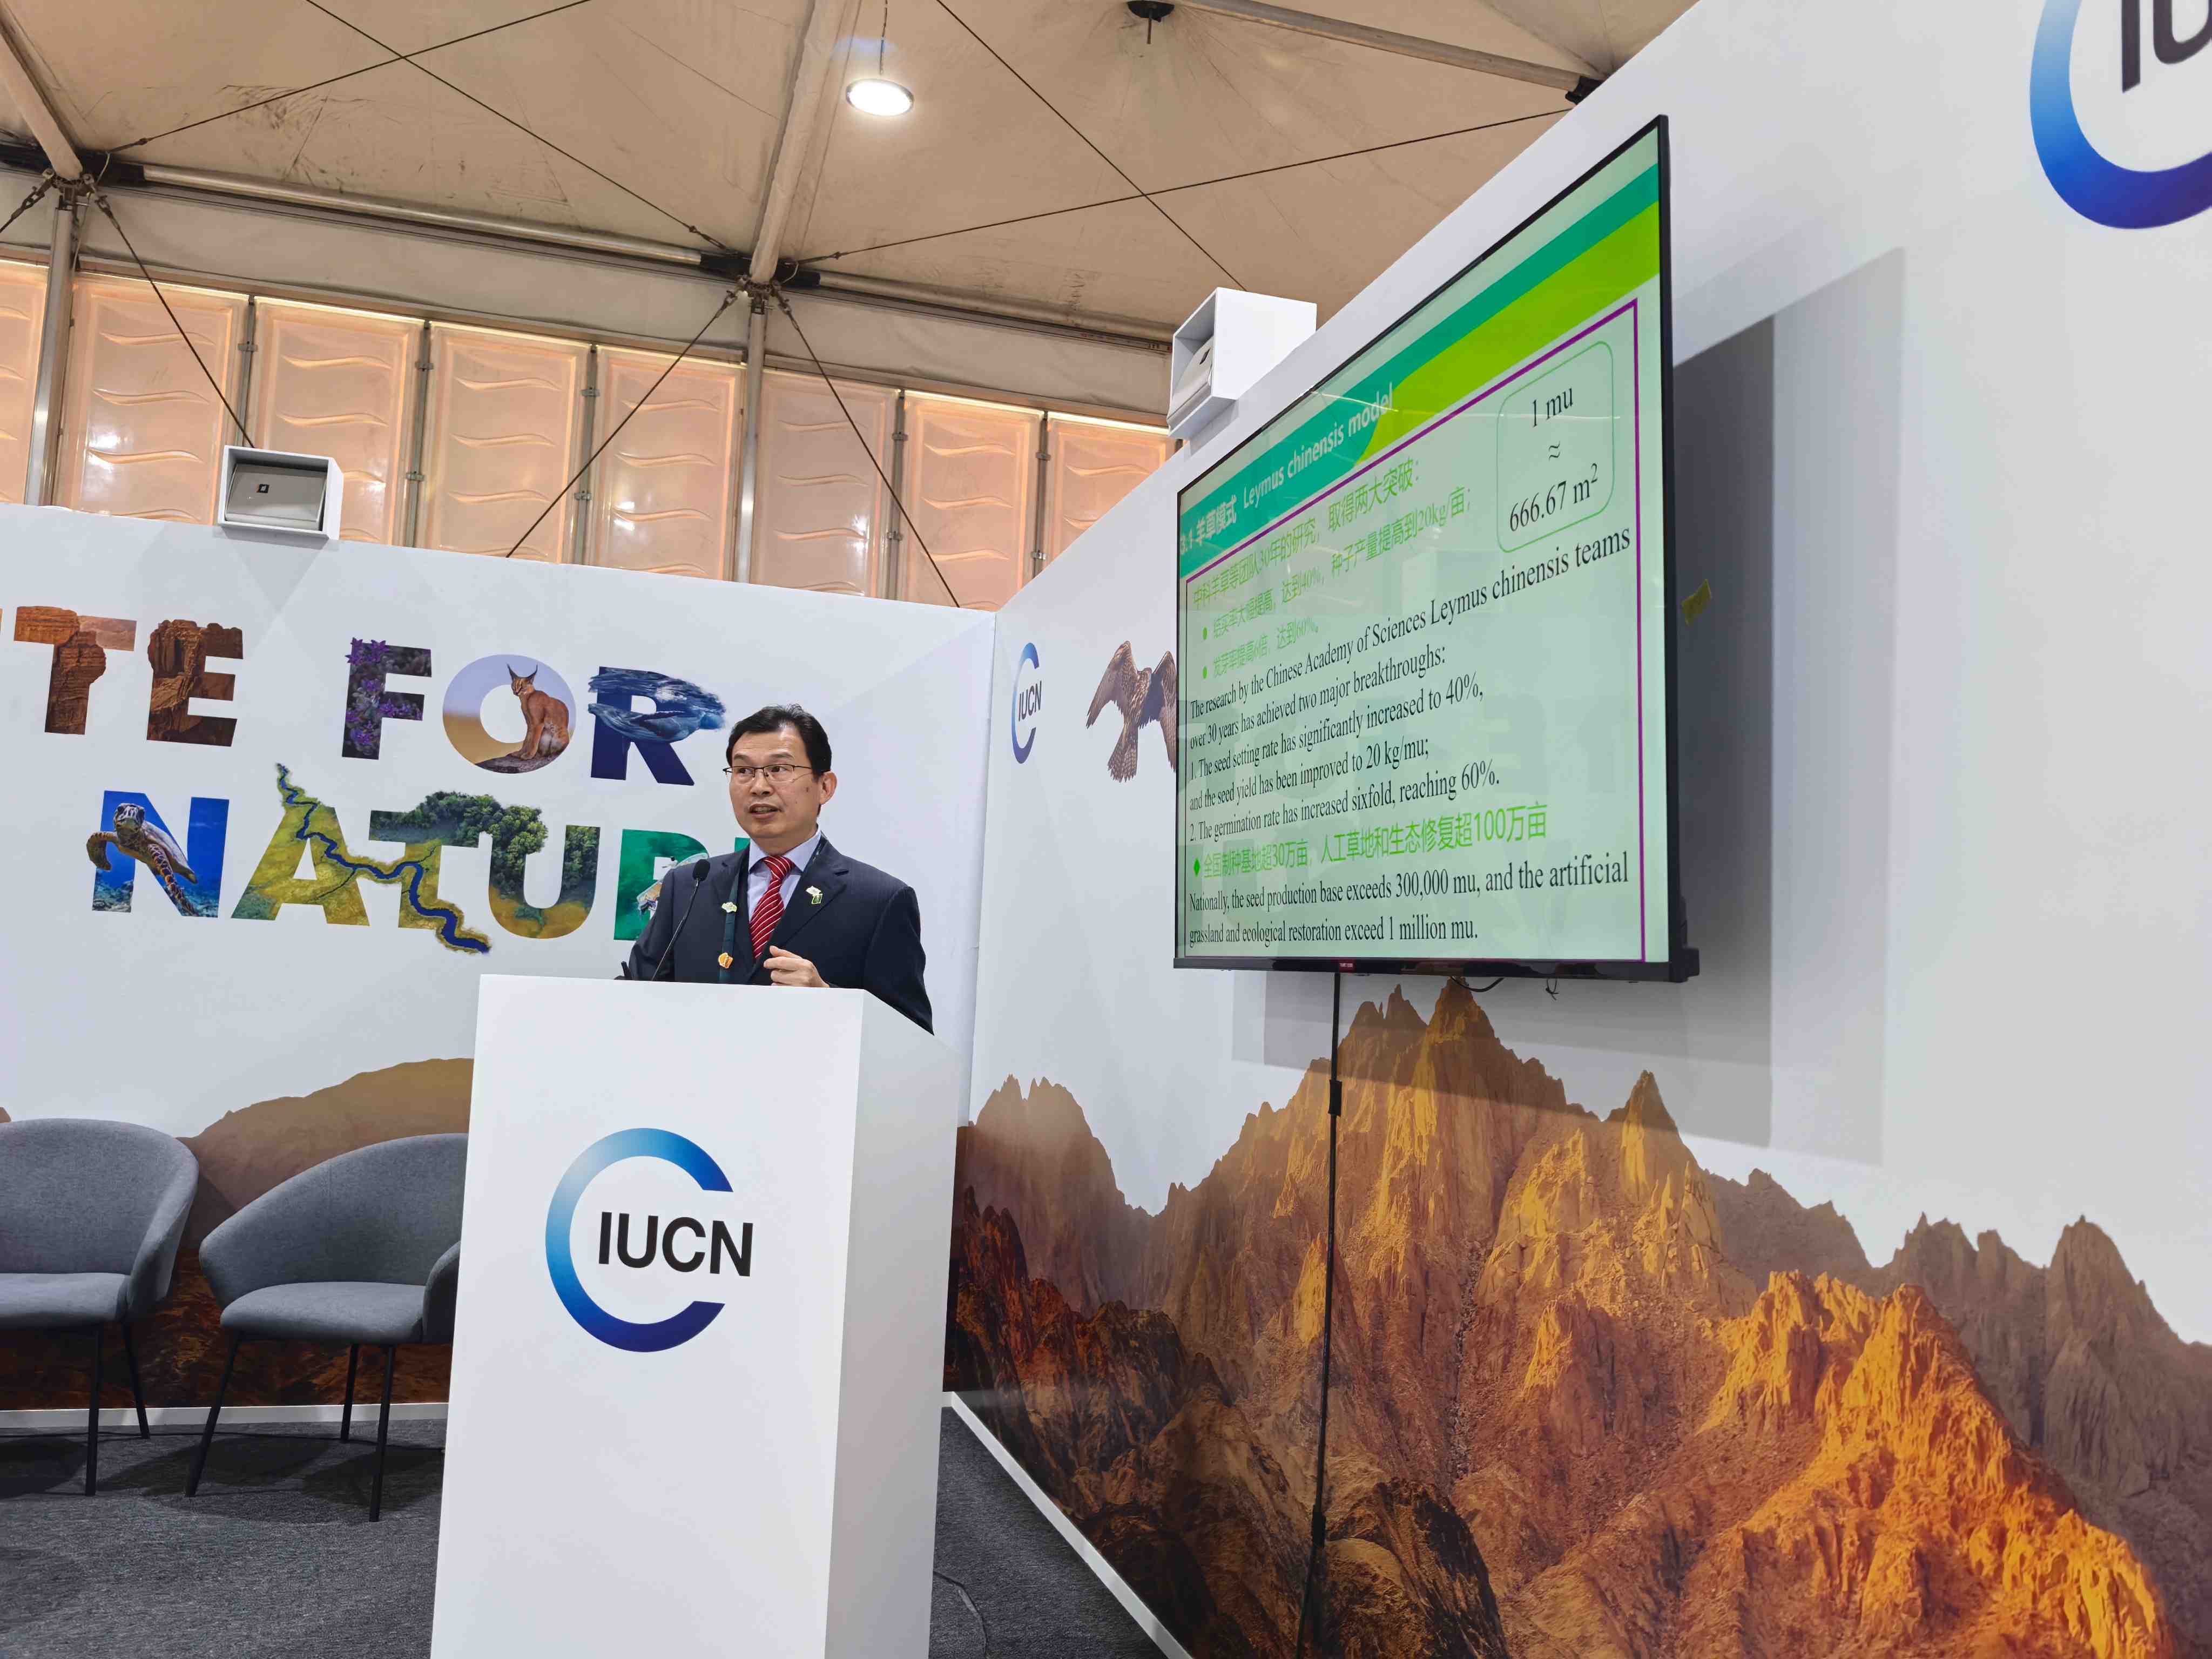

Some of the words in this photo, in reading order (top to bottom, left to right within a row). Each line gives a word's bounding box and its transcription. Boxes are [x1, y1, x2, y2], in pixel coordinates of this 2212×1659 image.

[2121, 0, 2212, 93] IU
[1244, 467, 1284, 508] Leymus
[1287, 422, 1344, 478] chinensis
[1348, 382, 1393, 436] model
[1533, 399, 1537, 428] 1
[1546, 388, 1573, 420] mu
[1510, 481, 1567, 532] 666.67
[1191, 700, 1204, 719] The
[1206, 685, 1236, 713] research
[1239, 681, 1249, 704] by
[1251, 675, 1264, 694] the
[1266, 664, 1303, 688] Chinese
[1305, 640, 1354, 674] Academy
[1357, 626, 1370, 652] of
[1373, 611, 1426, 646] Sciences
[1431, 586, 1487, 625] Leymus
[1493, 547, 1569, 599] chinensis
[1575, 528, 1630, 567] teams
[0, 605, 244, 747] TE
[342, 637, 726, 786] FOR
[1019, 680, 1042, 721] IUCN
[1190, 731, 1206, 750] over
[1208, 723, 1216, 744] 30
[1219, 720, 1239, 745] years
[1242, 713, 1254, 733] has
[1257, 693, 1296, 726] achieved
[1299, 694, 1317, 713] two
[1320, 677, 1351, 707] major
[1354, 644, 1446, 693] breakthroughs:
[1199, 757, 1212, 778] The
[1214, 750, 1231, 772] seed
[1233, 744, 1259, 767] setting
[1262, 740, 1278, 759] rate
[1281, 733, 1296, 754] has
[1299, 710, 1363, 752] significantly
[1367, 688, 1424, 729] increased
[1429, 689, 1441, 710] to
[1446, 671, 1483, 705] 40%,
[1190, 790, 1202, 811] and
[1205, 789, 1216, 807] the
[1218, 782, 1234, 805] seed
[1237, 774, 1257, 806] yield
[1259, 774, 1273, 794] has
[1276, 770, 1297, 790] been
[1300, 751, 1348, 788] improved
[1352, 752, 1363, 772] to
[1366, 743, 1380, 769] 20
[1385, 734, 1428, 770] kg/mu;
[1199, 820, 1212, 840] The
[1214, 810, 1261, 842] germination
[1264, 810, 1280, 828] rate
[1283, 803, 1298, 824] has
[1301, 790, 1348, 821] increased
[1352, 780, 1395, 811] sixfold,
[1399, 770, 1456, 803] reaching
[1461, 758, 1500, 790] 60%.
[86, 763, 751, 953] NATUR
[1190, 891, 1230, 915] Nationally,
[1232, 889, 1244, 908] the
[1246, 886, 1265, 908] seed
[1267, 882, 1317, 913] production
[1320, 880, 1343, 902] base
[1346, 874, 1392, 901] exceeds
[1395, 868, 1448, 901] 300,000
[1453, 874, 1481, 898] mu,
[1486, 862, 1513, 891] and
[1519, 860, 1543, 889] the
[1550, 851, 1629, 887] artificial
[1189, 923, 1224, 948] grassland
[1226, 922, 1240, 942] and
[1243, 920, 1286, 948] ecological
[1289, 918, 1341, 941] restoration
[1345, 916, 1384, 941] exceed
[1390, 916, 1394, 940] 1
[1399, 913, 1446, 940] million
[1451, 919, 1478, 940] mu.
[598, 1211, 753, 1277] IUCN
